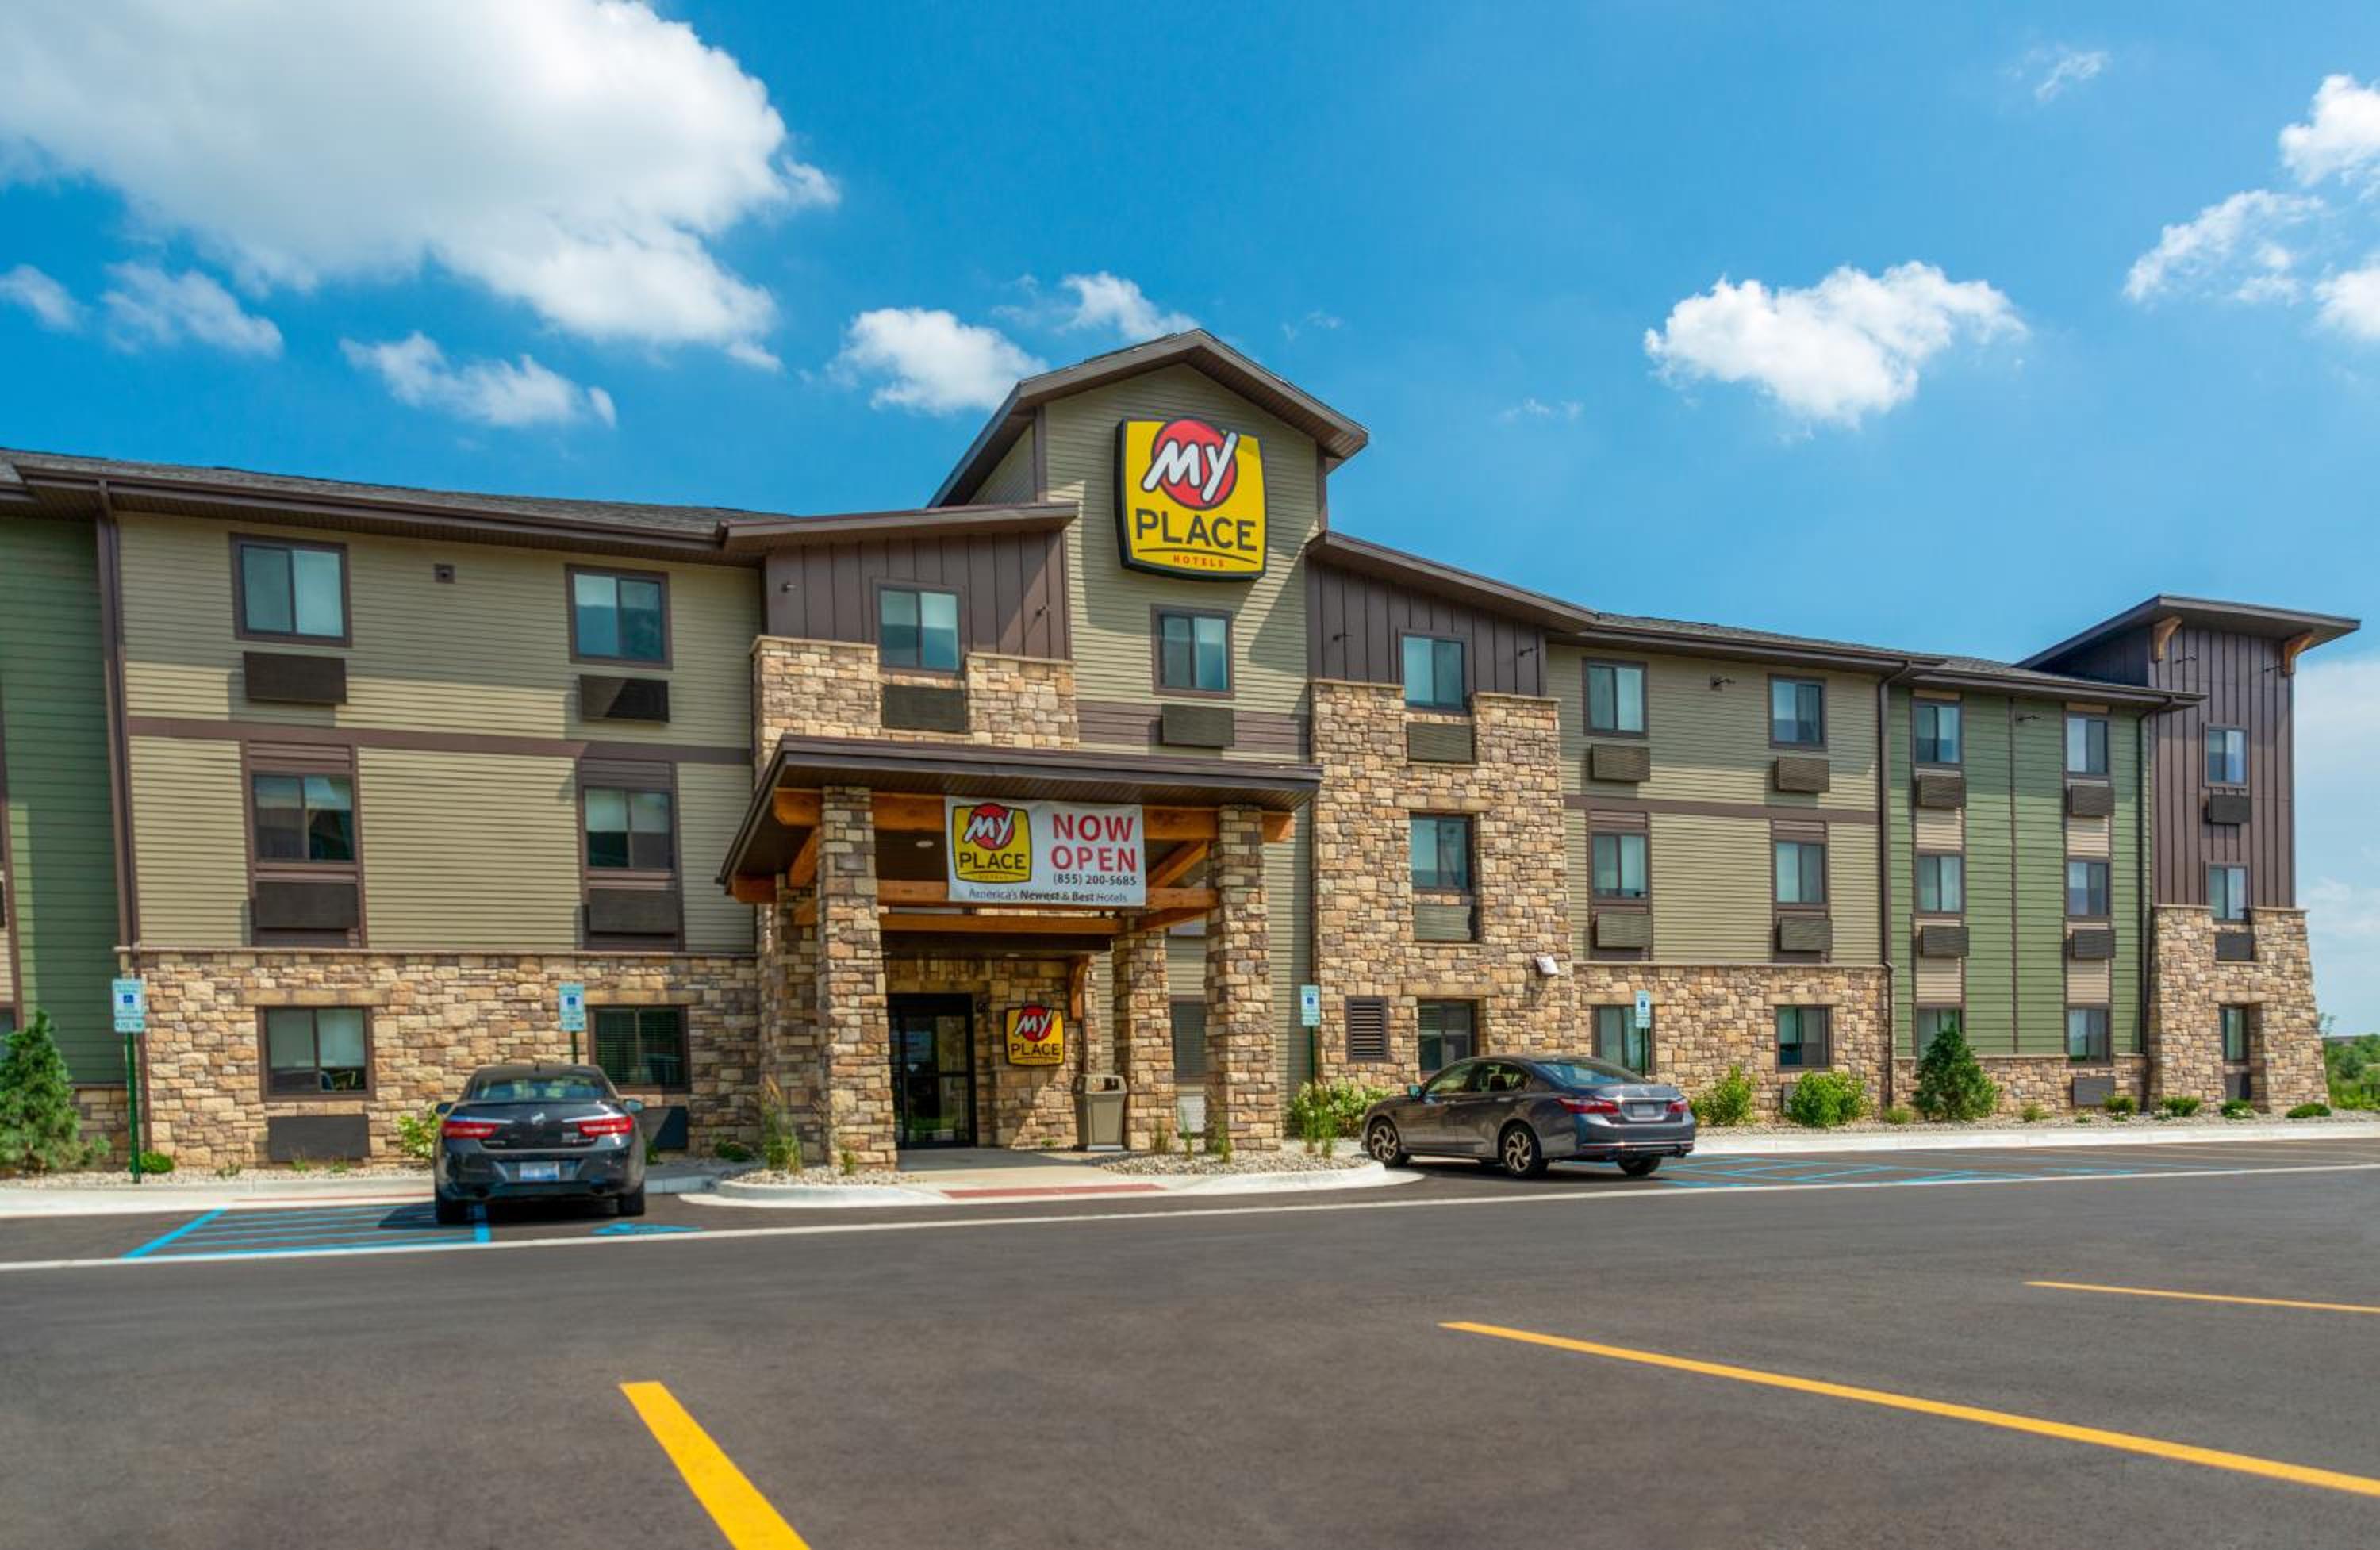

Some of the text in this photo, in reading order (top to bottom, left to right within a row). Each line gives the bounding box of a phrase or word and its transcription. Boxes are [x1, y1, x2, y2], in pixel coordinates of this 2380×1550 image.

[1135, 508, 1257, 551] PLACE
[1173, 554, 1225, 568] HOTELS
[1053, 813, 1134, 842] NOW
[959, 851, 1027, 870] PLACE
[1051, 845, 1138, 873] OPEN
[1053, 873, 1137, 886] (855) 200-5685
[969, 888, 1017, 900] America's
[1019, 890, 1059, 901] Newest
[1072, 891, 1095, 902] Best
[1096, 892, 1128, 903] Hotels
[1011, 1042, 1061, 1056] PLACE
